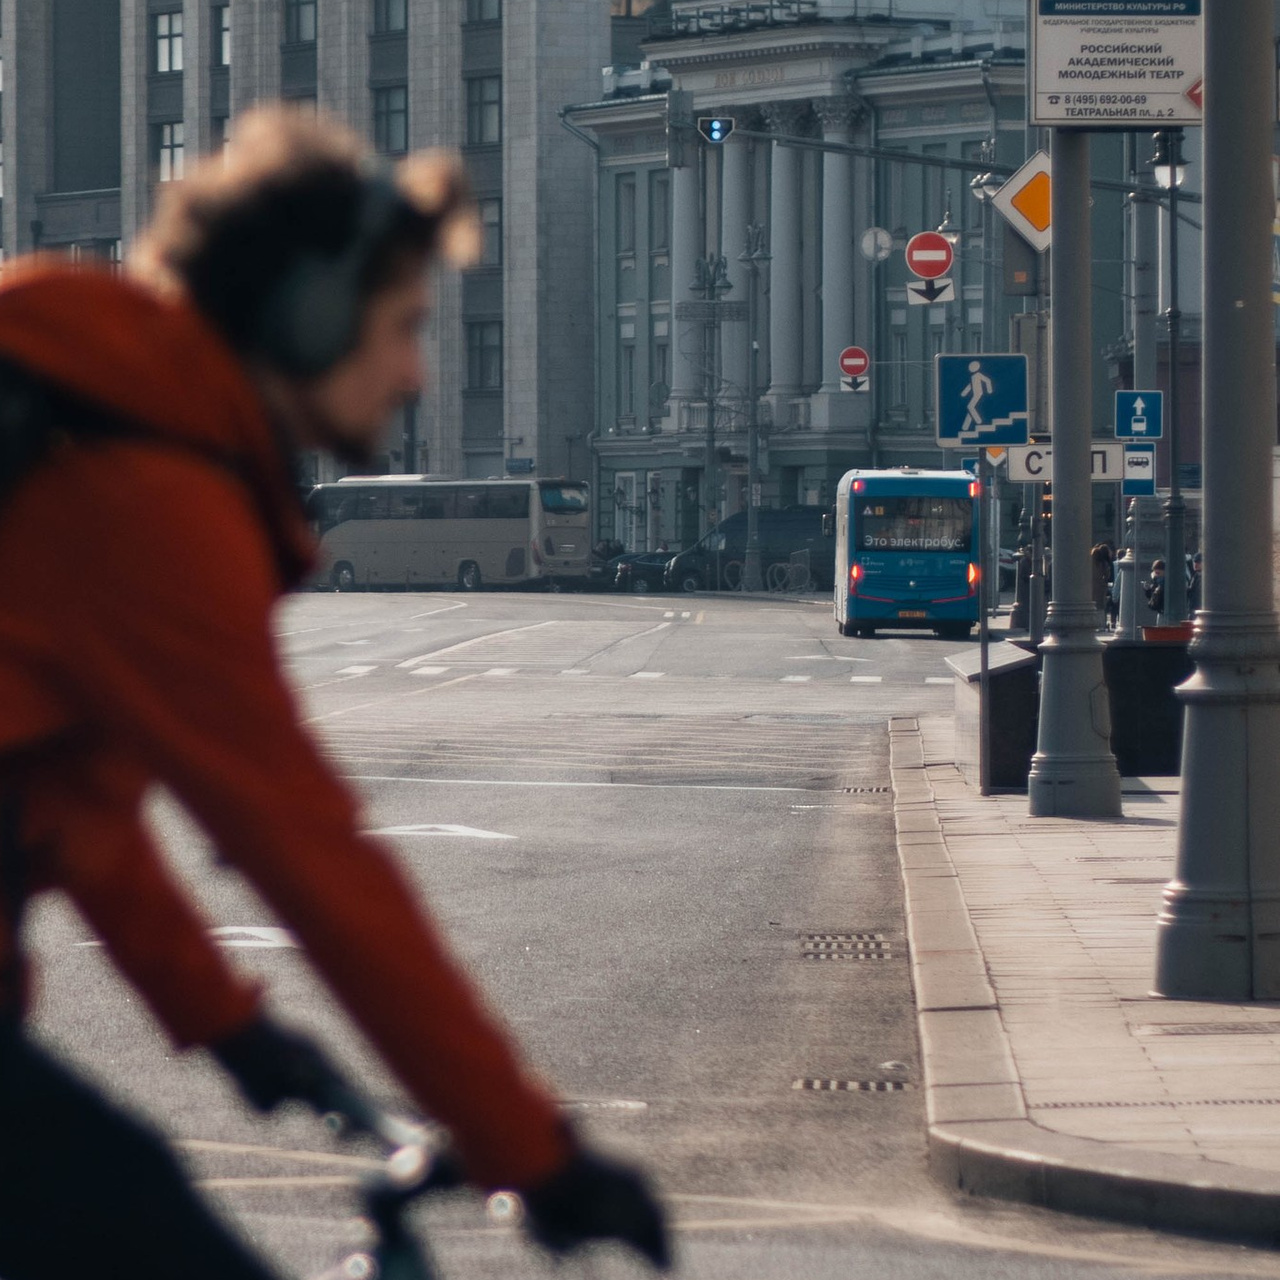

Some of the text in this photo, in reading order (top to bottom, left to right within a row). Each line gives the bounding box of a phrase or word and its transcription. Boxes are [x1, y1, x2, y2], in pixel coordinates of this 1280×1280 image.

[1055, 2, 1186, 11] МИНИСТЕРСТВО КУЛЬТУРЫ РФ
[1080, 43, 1162, 53] РОССИЙСКИЙ
[1068, 56, 1174, 67] АКАДЕМИЧЕСКИЙ
[1058, 69, 1184, 80] МОЛОДЕЖНЫЙ ТЕАТР
[1064, 95, 1147, 106] 8 (495) 692-00-69
[1065, 108, 1136, 116] ТЕАТРАЛЬНАЯ
[1167, 108, 1174, 116] 2
[1025, 450, 1107, 475] СП
[864, 535, 964, 549] Это электробус.
